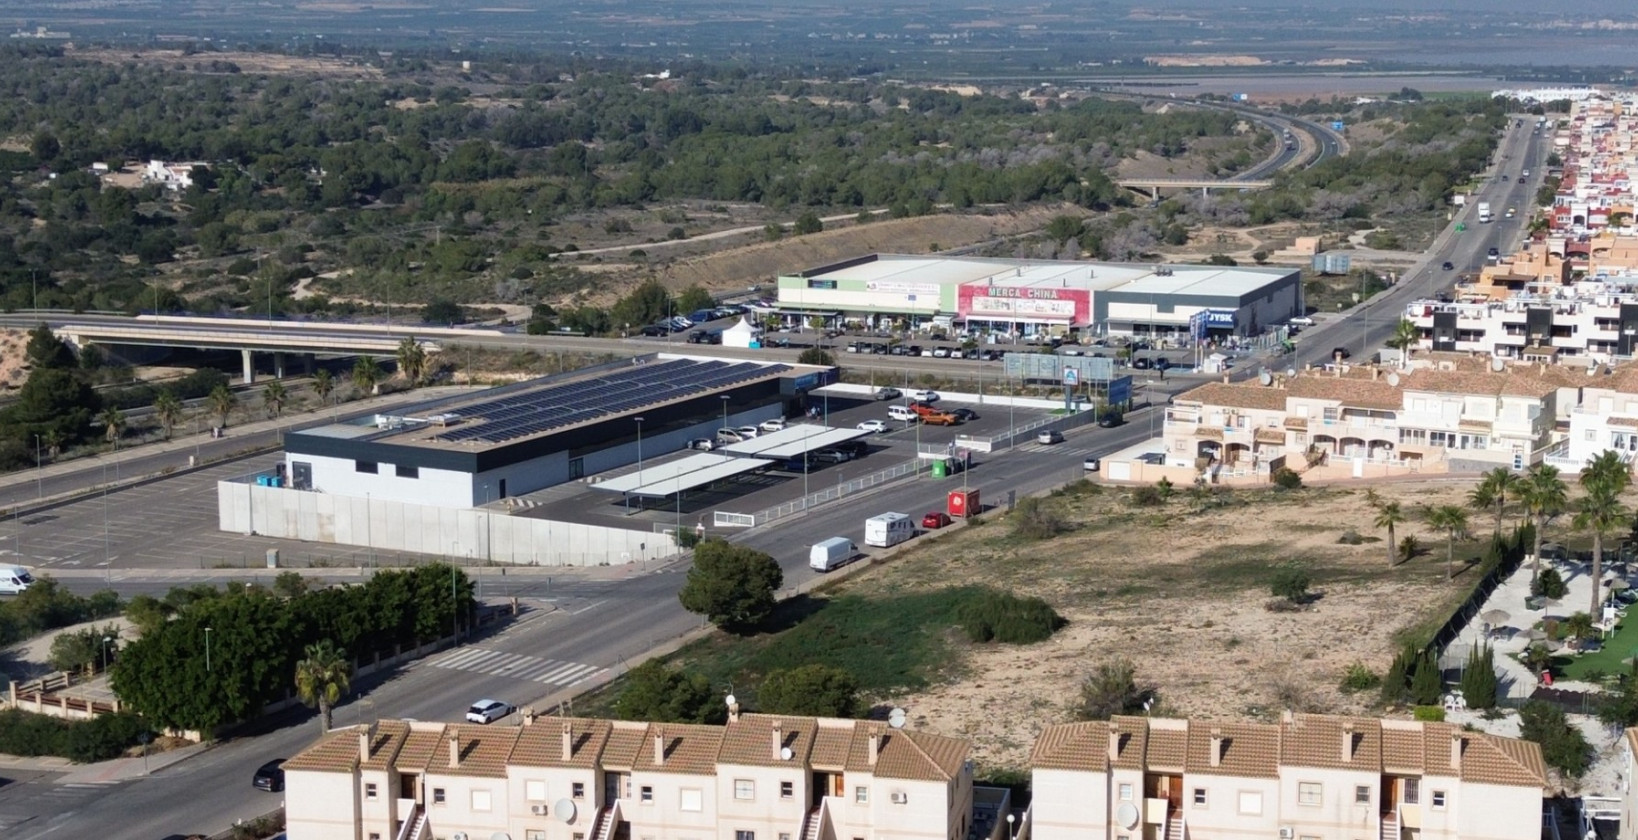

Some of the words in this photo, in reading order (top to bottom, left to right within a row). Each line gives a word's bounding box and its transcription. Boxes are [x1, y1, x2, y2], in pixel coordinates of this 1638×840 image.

[988, 287, 1021, 297] MERCA
[1027, 287, 1058, 299] CHINA
[1209, 313, 1233, 322] JYSK
